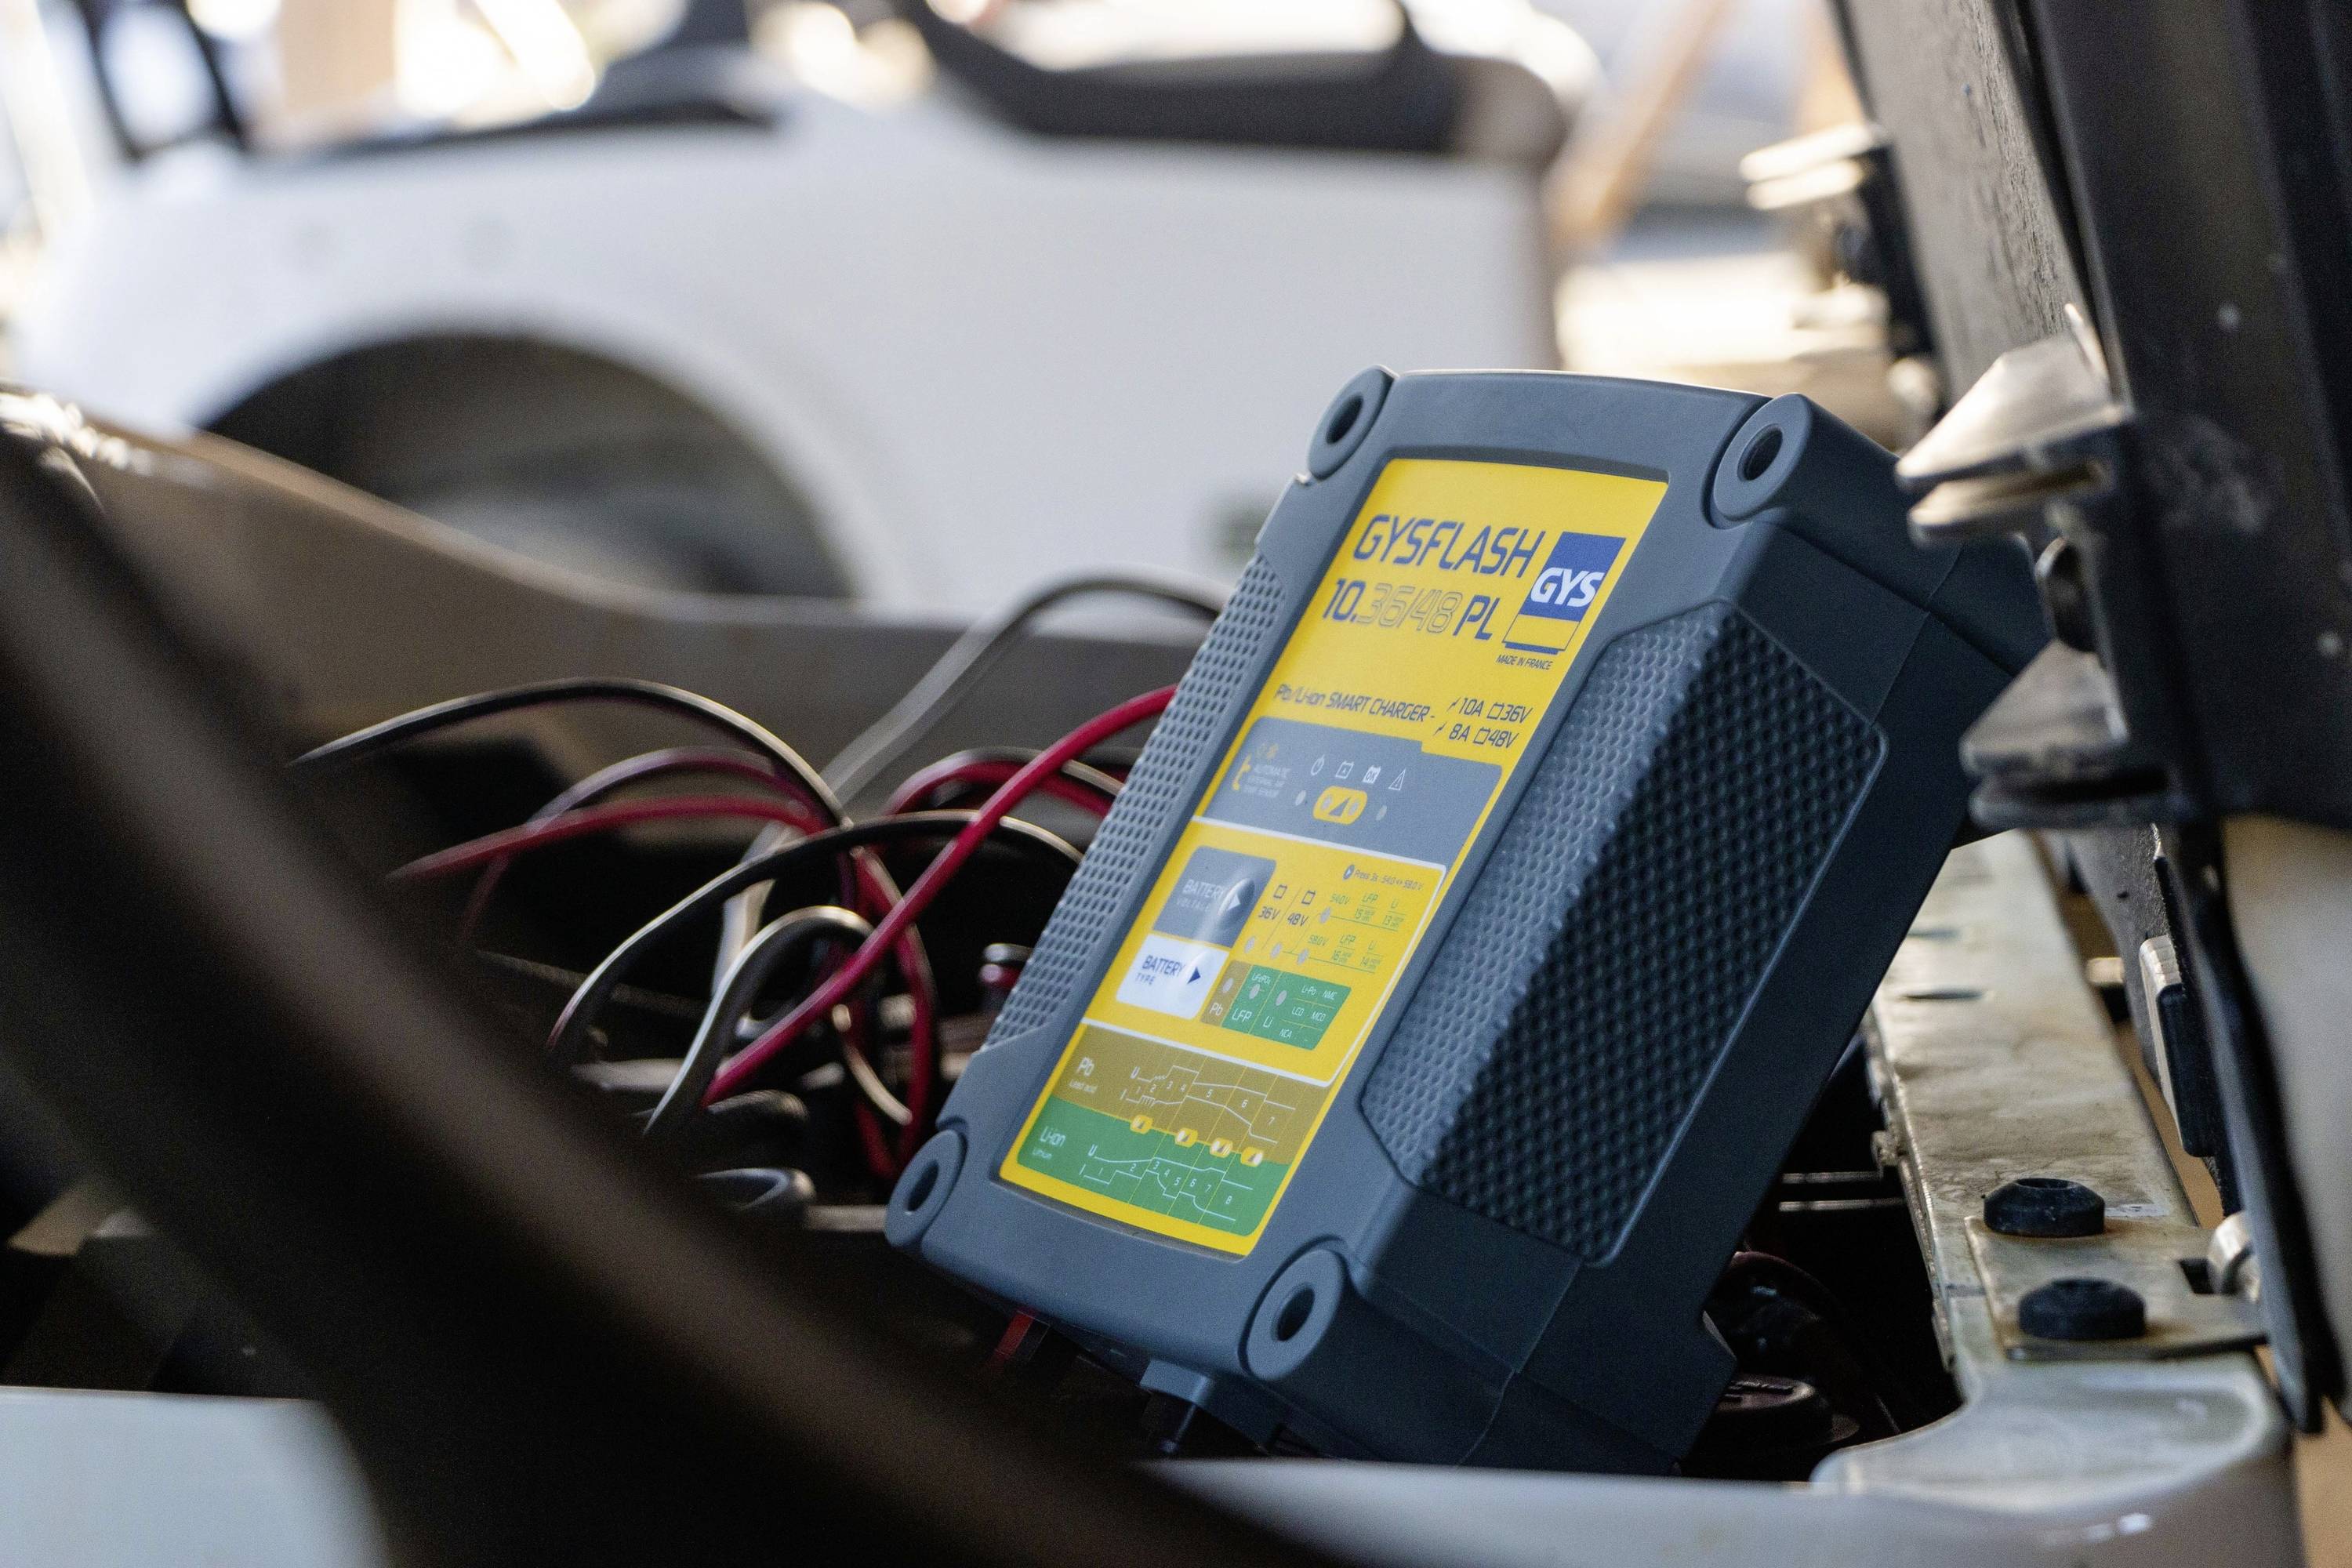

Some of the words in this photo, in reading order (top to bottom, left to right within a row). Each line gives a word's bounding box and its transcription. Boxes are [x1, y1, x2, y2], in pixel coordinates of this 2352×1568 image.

[1353, 514, 1546, 579] GYSFLASH
[1530, 567, 1605, 608] GYS
[1452, 594, 1501, 641] PL
[1496, 654, 1519, 665] MADE
[1517, 657, 1525, 666] IN
[1524, 658, 1554, 670] FRANCE
[1326, 691, 1371, 713] SMART
[1369, 698, 1431, 722] CHARGER
[1459, 697, 1484, 717] 10A
[1499, 703, 1534, 724] 36V
[1448, 723, 1468, 742] 8A
[1487, 728, 1519, 748] 48V
[1361, 893, 1378, 904] LFP
[1339, 934, 1356, 945] LFP
[1142, 954, 1185, 977] BATTERY
[1135, 972, 1156, 985] TYPE
[1210, 1003, 1223, 1016] Pb
[1232, 1007, 1254, 1023] LFP
[1291, 1007, 1305, 1017] LCO
[1076, 1057, 1095, 1076] Pb
[1150, 1083, 1157, 1093] 2
[1166, 1080, 1174, 1090] 3
[1180, 1083, 1187, 1092] 4
[1206, 1089, 1214, 1098] 5
[1241, 1099, 1249, 1109] 6
[1267, 1116, 1276, 1126] 7
[1130, 1163, 1137, 1172] 2
[1152, 1161, 1160, 1170] 3
[1174, 1177, 1181, 1186] 5
[1189, 1178, 1197, 1188] 6
[1204, 1184, 1212, 1193] 7
[1225, 1195, 1233, 1205] 8
